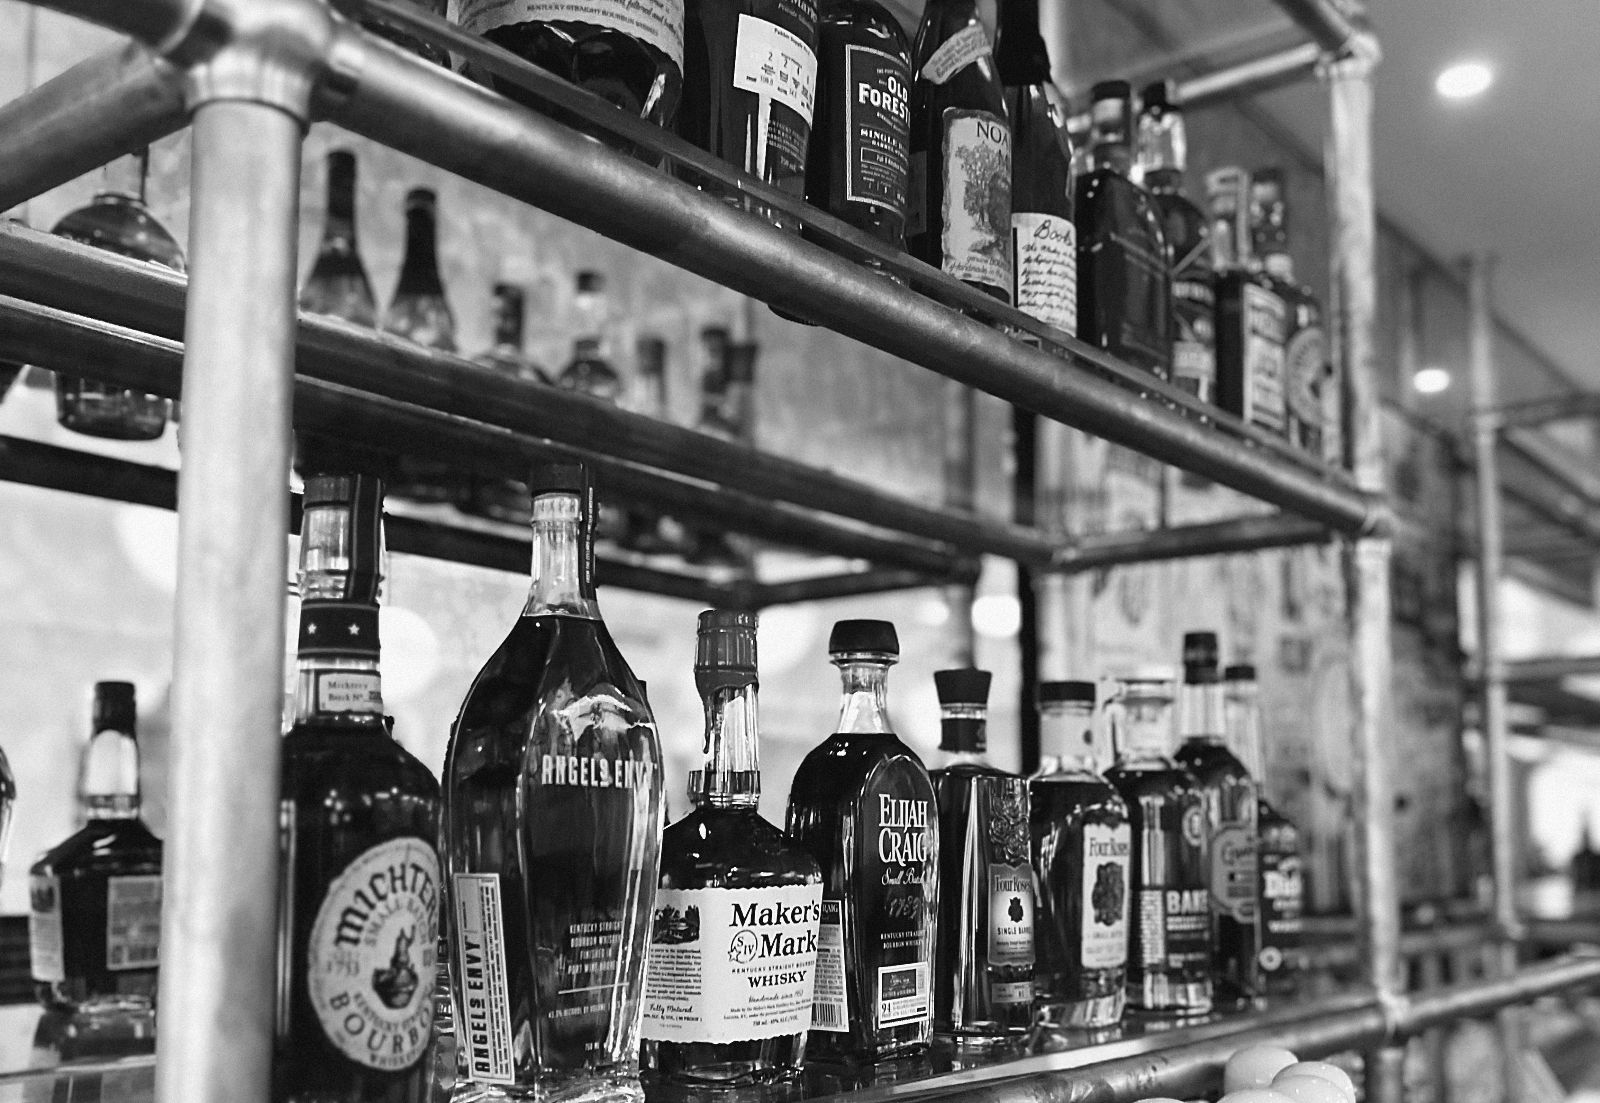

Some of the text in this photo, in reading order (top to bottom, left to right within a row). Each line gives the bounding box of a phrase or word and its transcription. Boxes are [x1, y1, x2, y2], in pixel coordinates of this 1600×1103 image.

[887, 76, 908, 104] OLD
[878, 793, 929, 833] ELIJAH
[878, 827, 928, 866] CRAIG
[881, 866, 905, 886] Small
[728, 900, 820, 928] Maker's
[821, 903, 839, 914] RAIG
[880, 931, 905, 940] KENTUCKY
[997, 926, 1017, 936] SINGLE
[758, 929, 817, 958] Mark
[883, 941, 905, 950] BOURBON
[464, 935, 486, 991] ENVY
[768, 962, 794, 972] STRAIGHT
[747, 970, 807, 988] WHISKY
